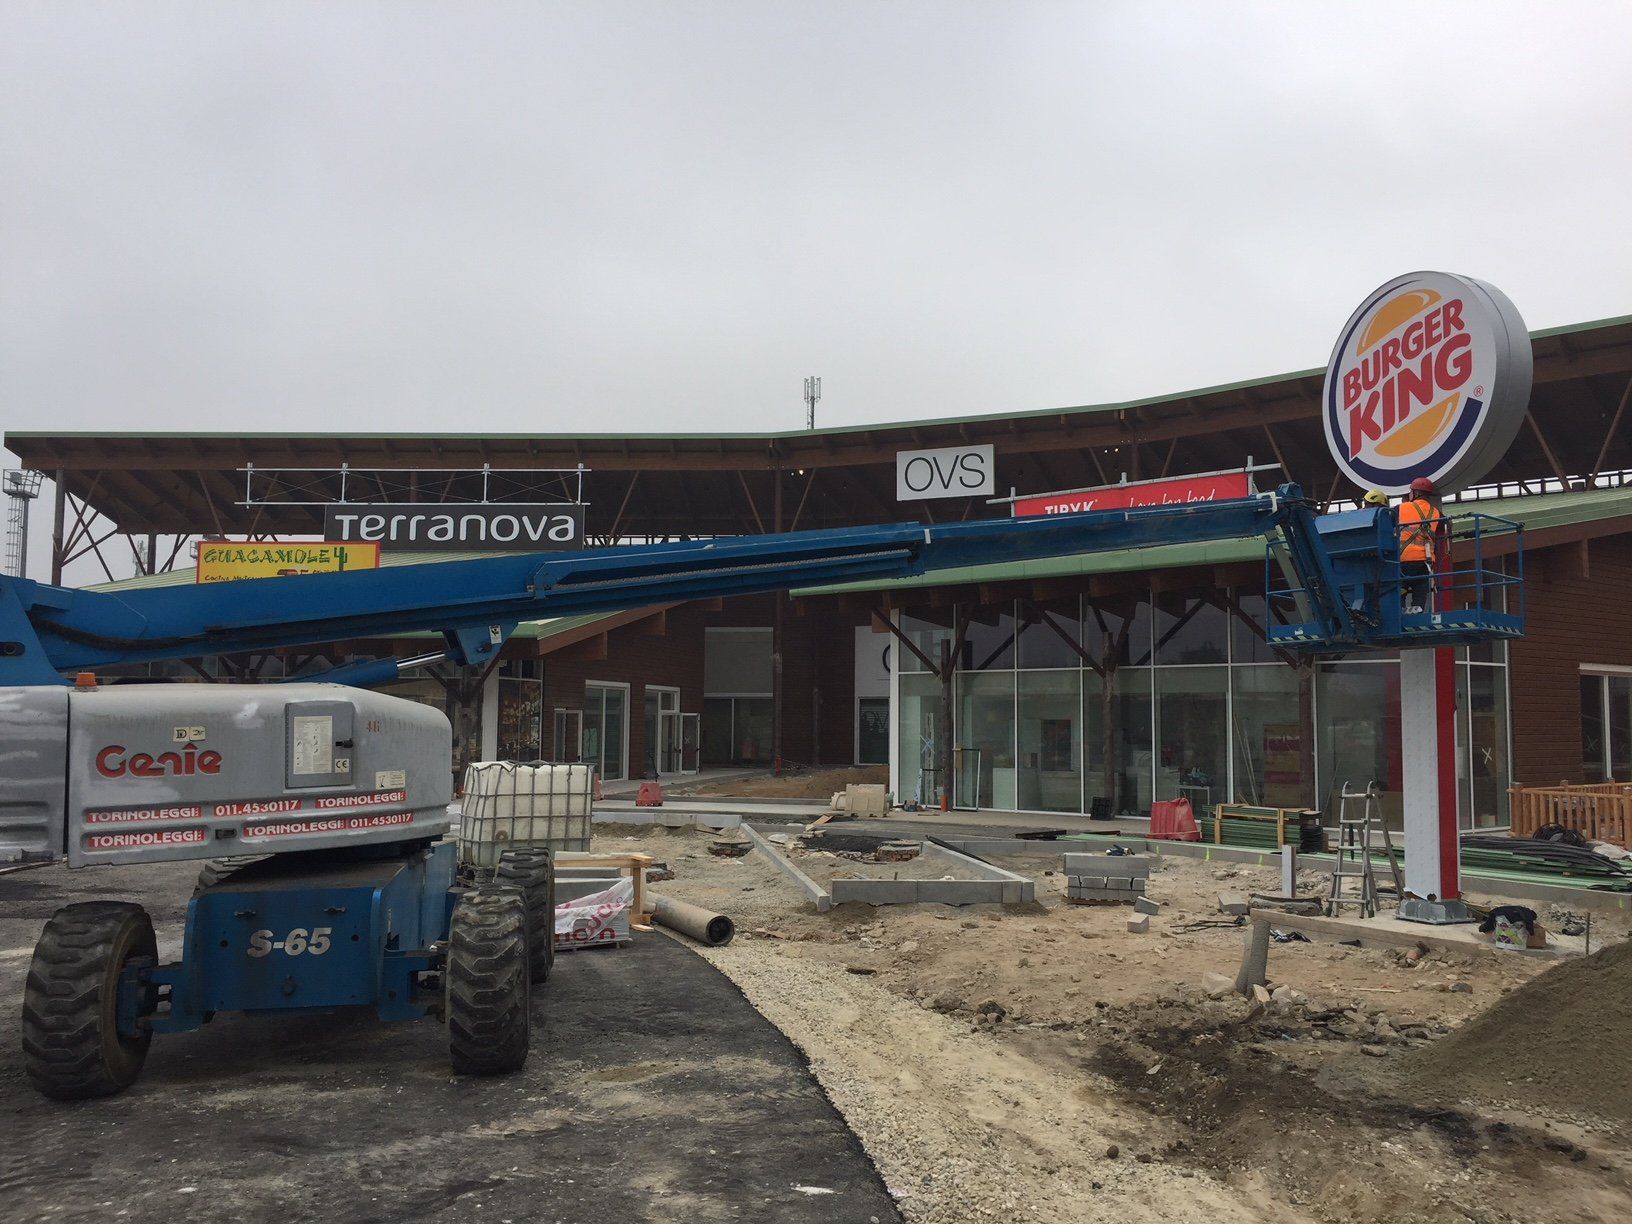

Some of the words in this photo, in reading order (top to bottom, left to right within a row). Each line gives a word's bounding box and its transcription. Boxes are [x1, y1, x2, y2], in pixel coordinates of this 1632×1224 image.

[1343, 298, 1465, 411] BURGER
[1349, 332, 1473, 460] KING
[904, 452, 985, 492] OVS
[203, 548, 330, 564] GUACAMOLE
[95, 742, 222, 778] Genie
[215, 799, 300, 817] 011.4530117
[350, 813, 412, 828] 011.4530117
[247, 927, 332, 957] S-65
